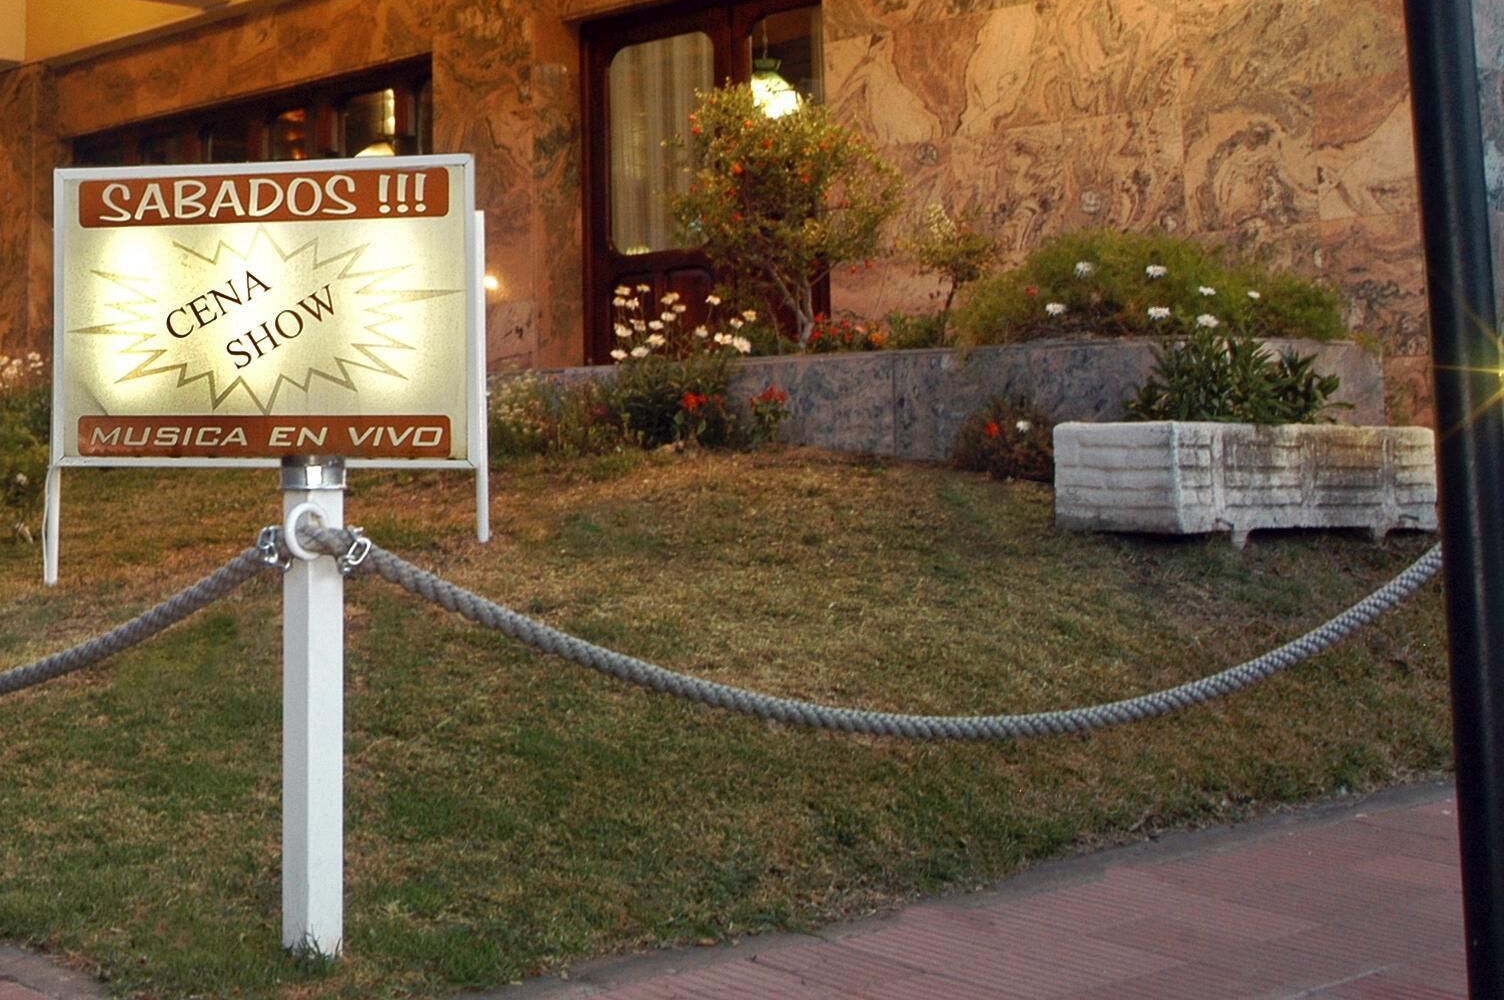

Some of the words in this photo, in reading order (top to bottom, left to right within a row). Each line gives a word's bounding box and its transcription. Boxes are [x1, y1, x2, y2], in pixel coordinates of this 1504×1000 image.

[99, 174, 357, 222] SABADOS
[165, 270, 272, 340] CENA
[225, 284, 336, 370] SHOW
[90, 426, 248, 447] MUSICA
[268, 426, 328, 447] EN
[348, 426, 444, 447] VIVO
